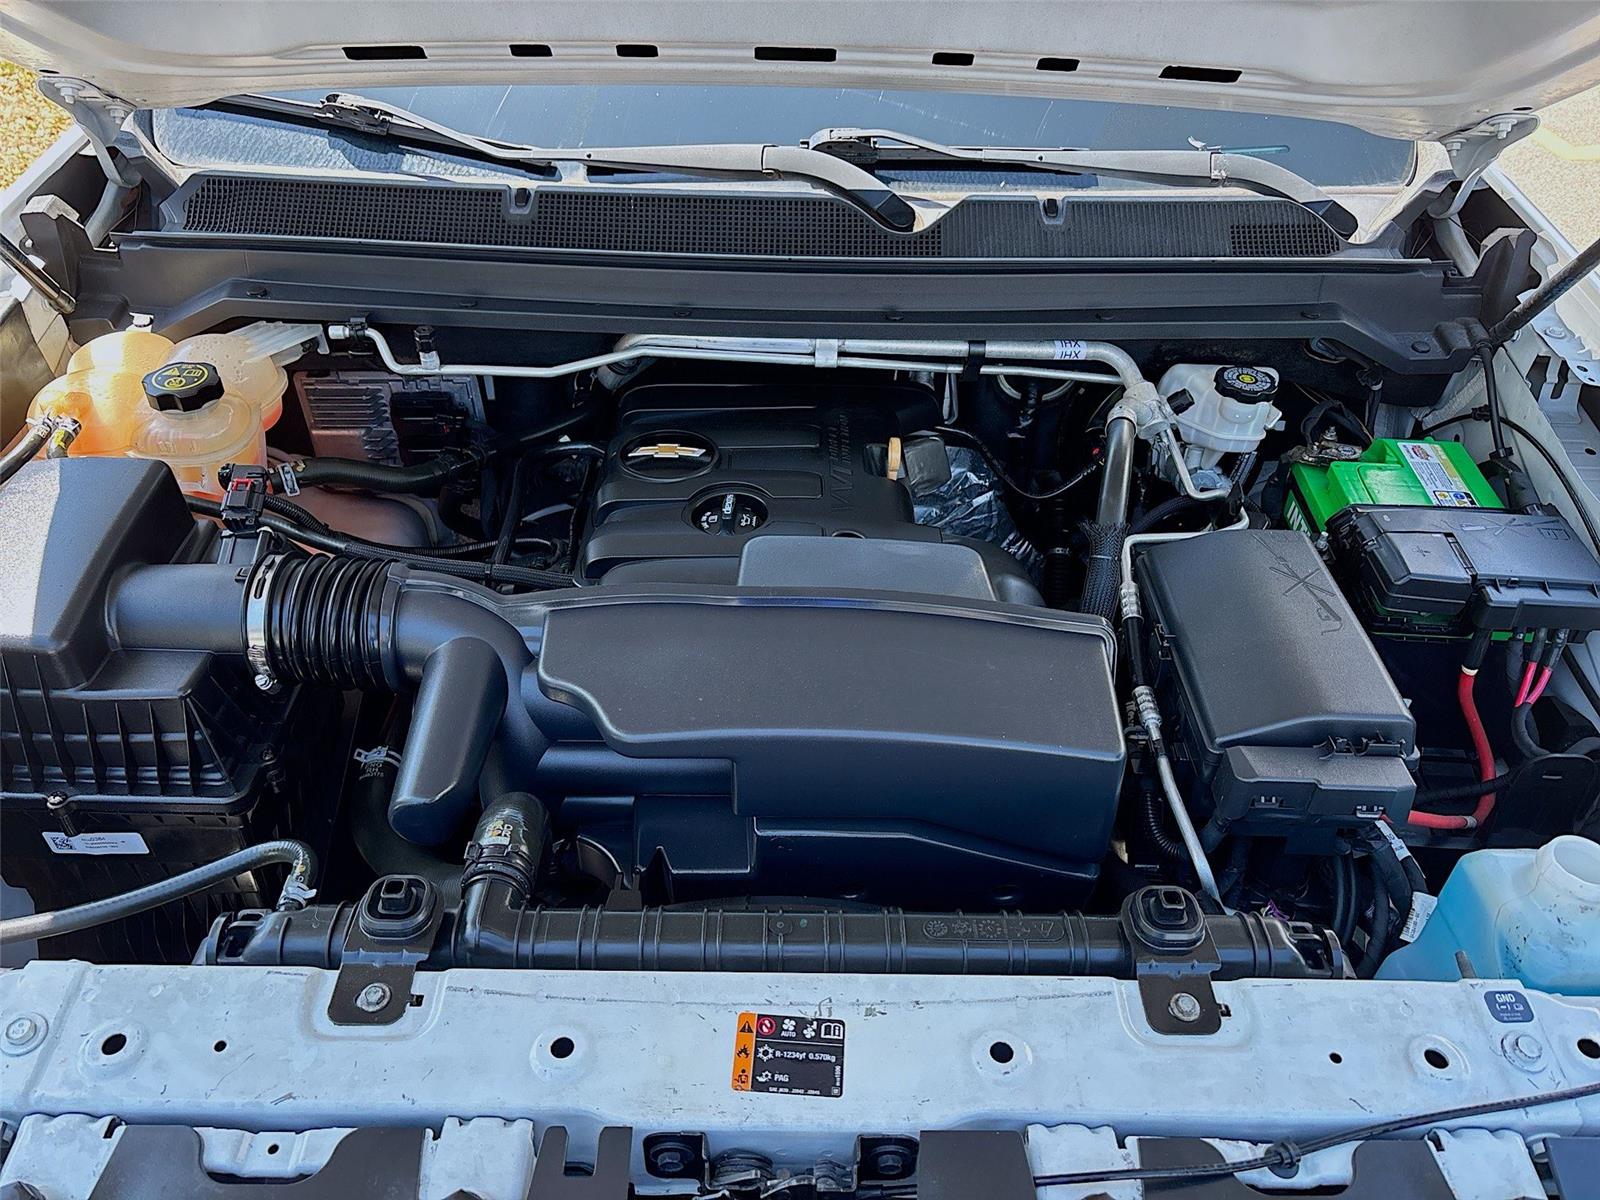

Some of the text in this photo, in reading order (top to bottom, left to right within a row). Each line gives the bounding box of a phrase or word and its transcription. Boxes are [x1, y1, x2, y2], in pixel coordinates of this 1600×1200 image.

[1495, 993, 1516, 1003] GND
[775, 1050, 807, 1061] R-1234yf
[808, 1052, 836, 1063] 0.570kg
[774, 1073, 790, 1082] PAG
